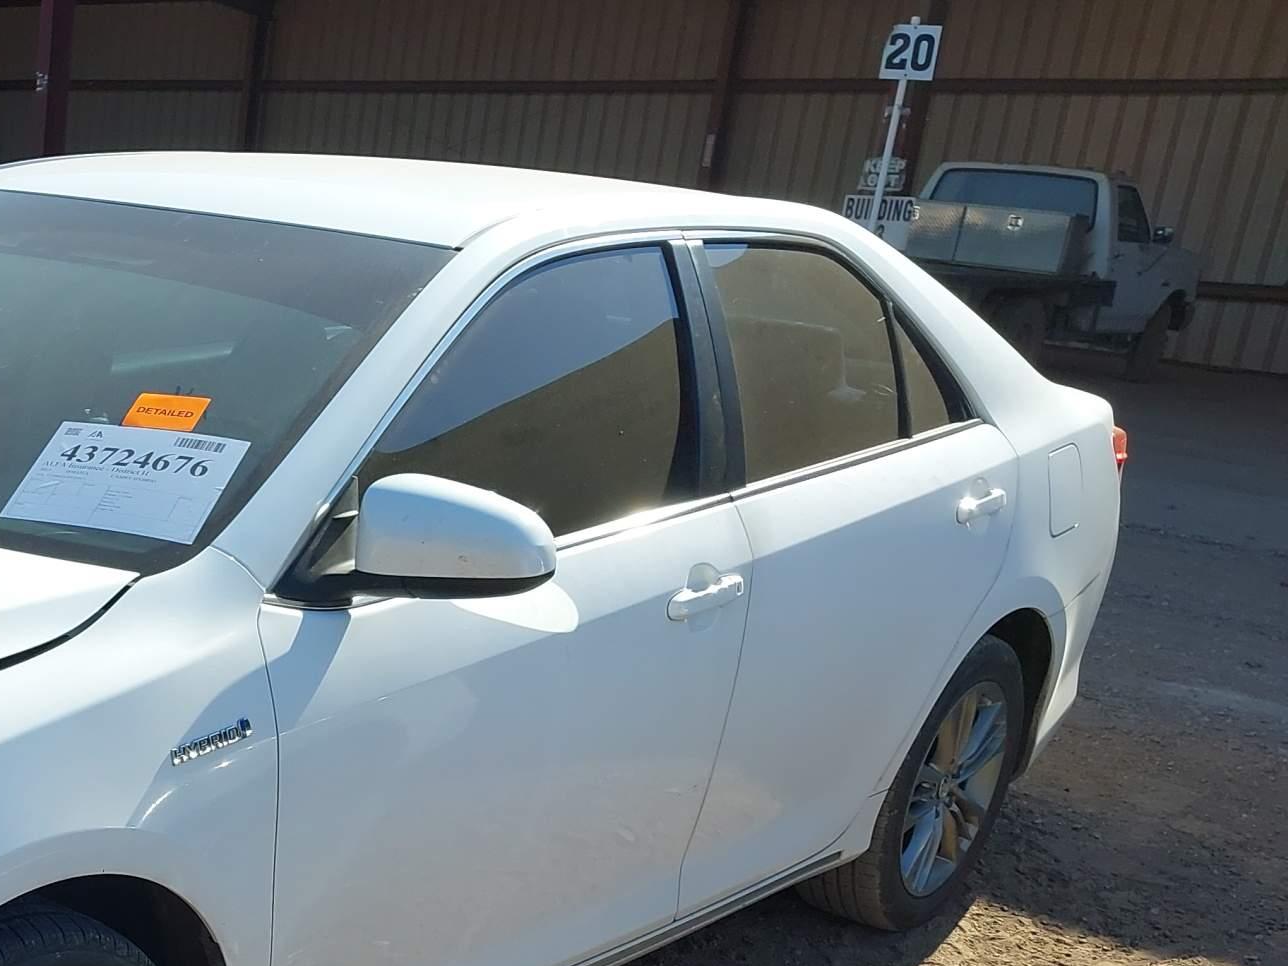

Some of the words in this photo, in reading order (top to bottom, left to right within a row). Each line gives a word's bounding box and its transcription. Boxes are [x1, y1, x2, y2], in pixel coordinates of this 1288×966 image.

[884, 33, 935, 72] 20
[867, 174, 899, 187] OT
[845, 198, 914, 222] BUIDING
[136, 406, 194, 419] DETAILED
[60, 444, 215, 478] 43724676
[170, 725, 241, 766] HYBRID
